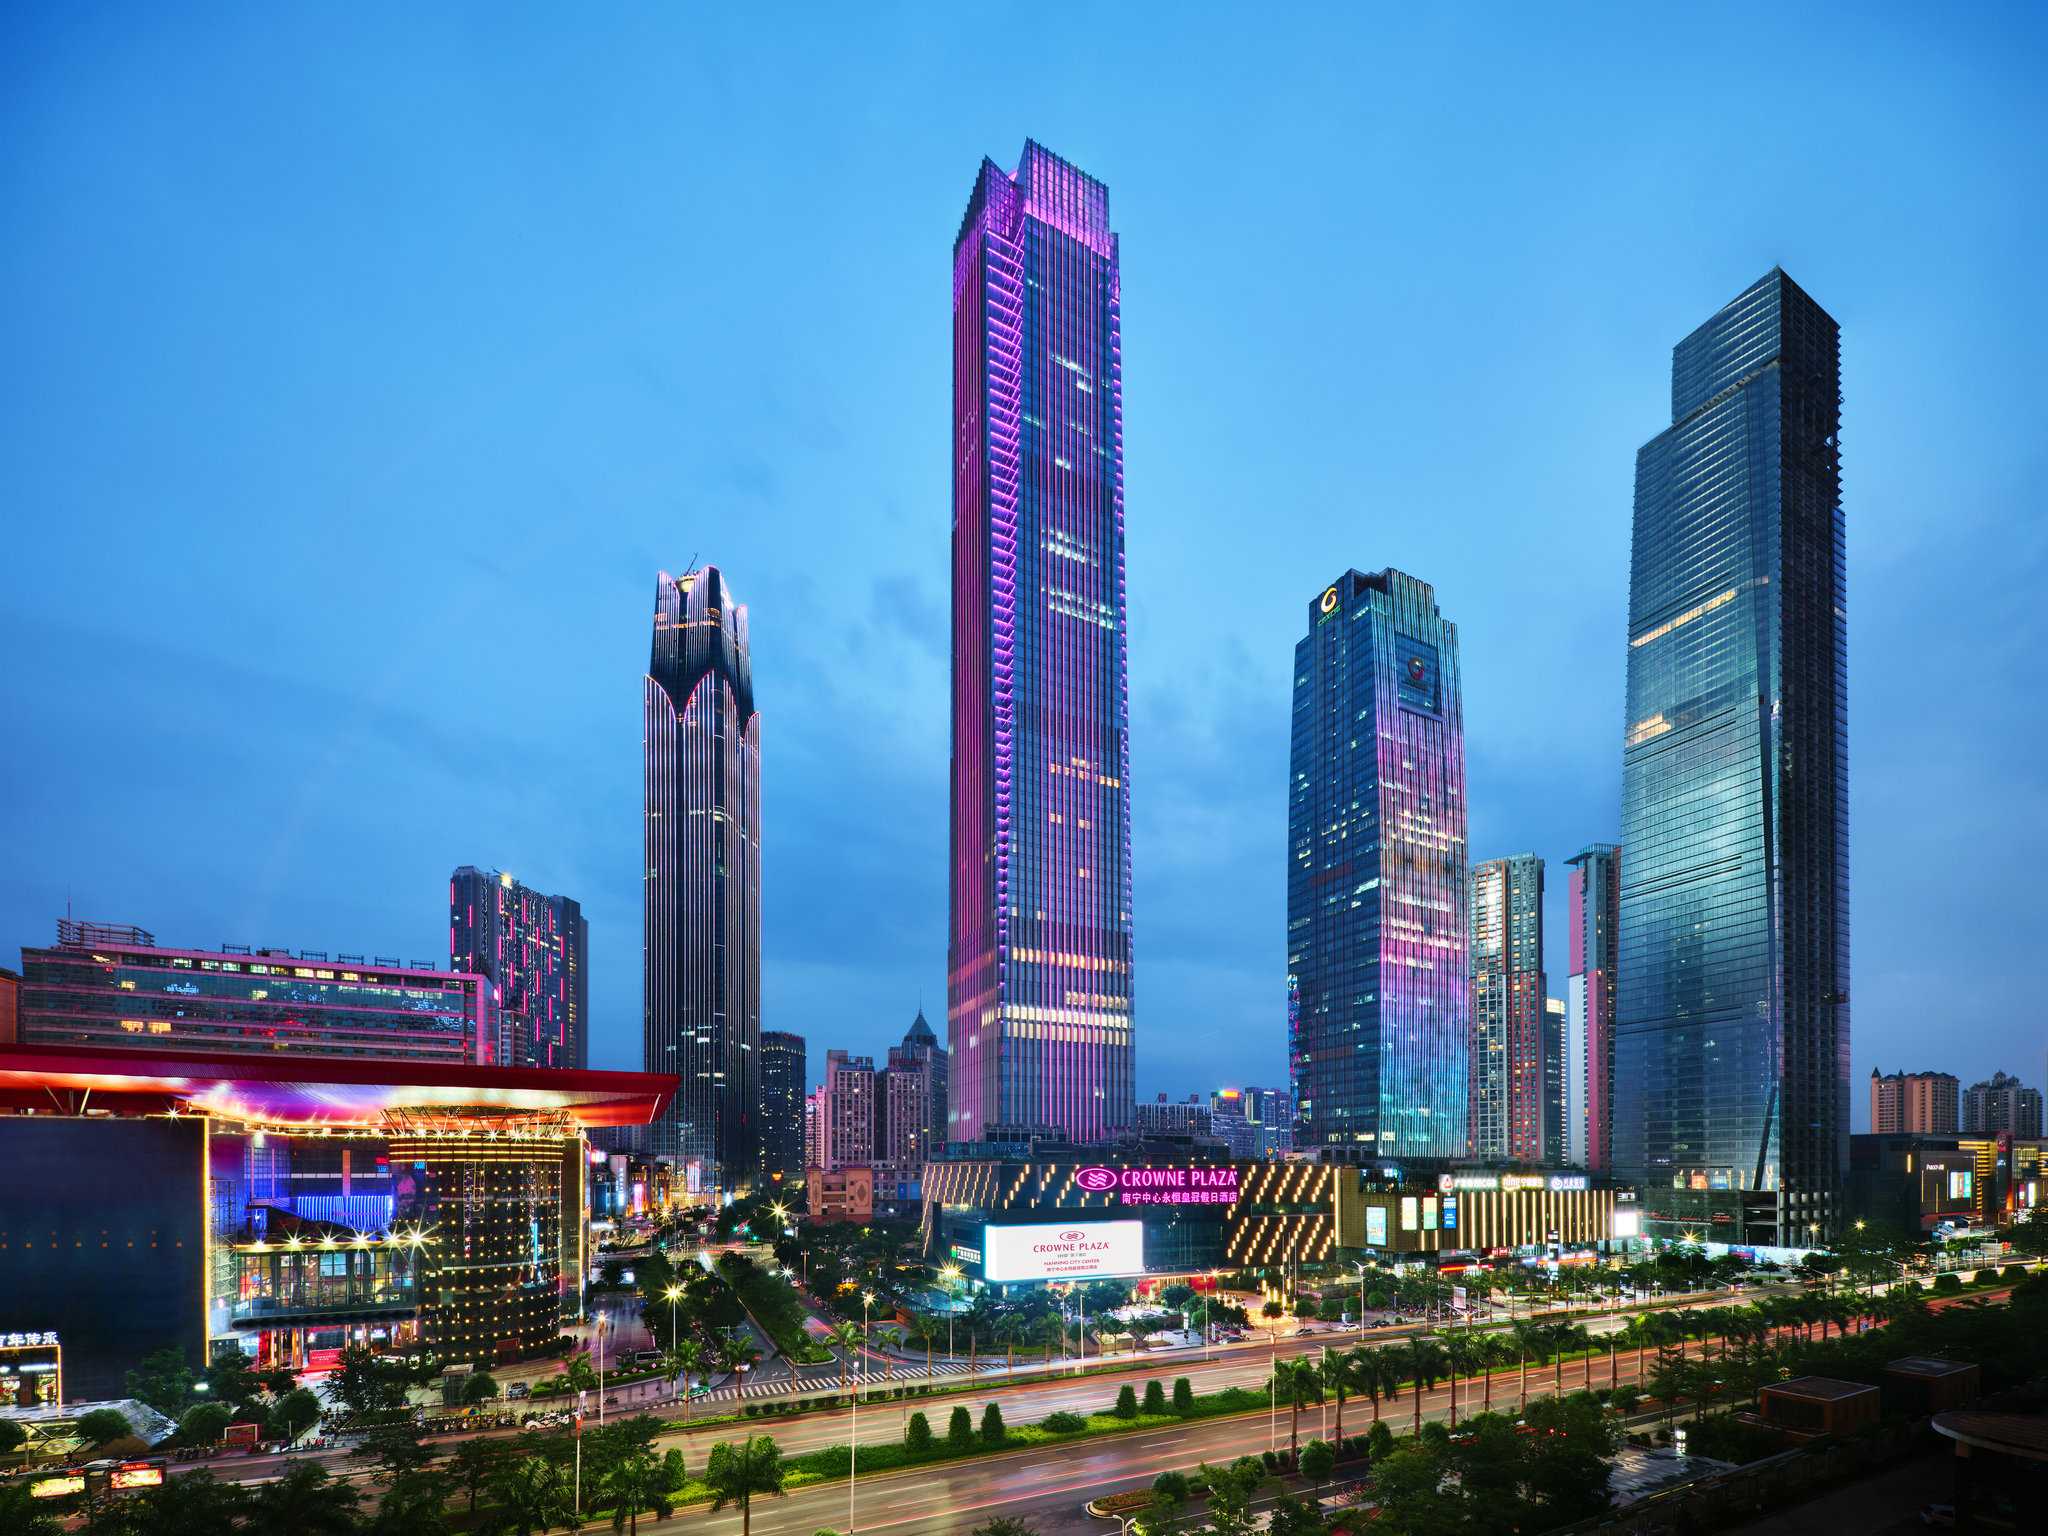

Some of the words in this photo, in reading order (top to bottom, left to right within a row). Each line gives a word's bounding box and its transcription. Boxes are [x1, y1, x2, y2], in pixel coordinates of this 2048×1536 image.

[1122, 1170, 1185, 1187] CROWNE
[1192, 1170, 1237, 1187] PLAZA
[1122, 1191, 1238, 1204] 南宁中心永恒皇冠假日酒店
[1033, 1243, 1075, 1253] CROWNE
[1079, 1241, 1109, 1251] PLAZA
